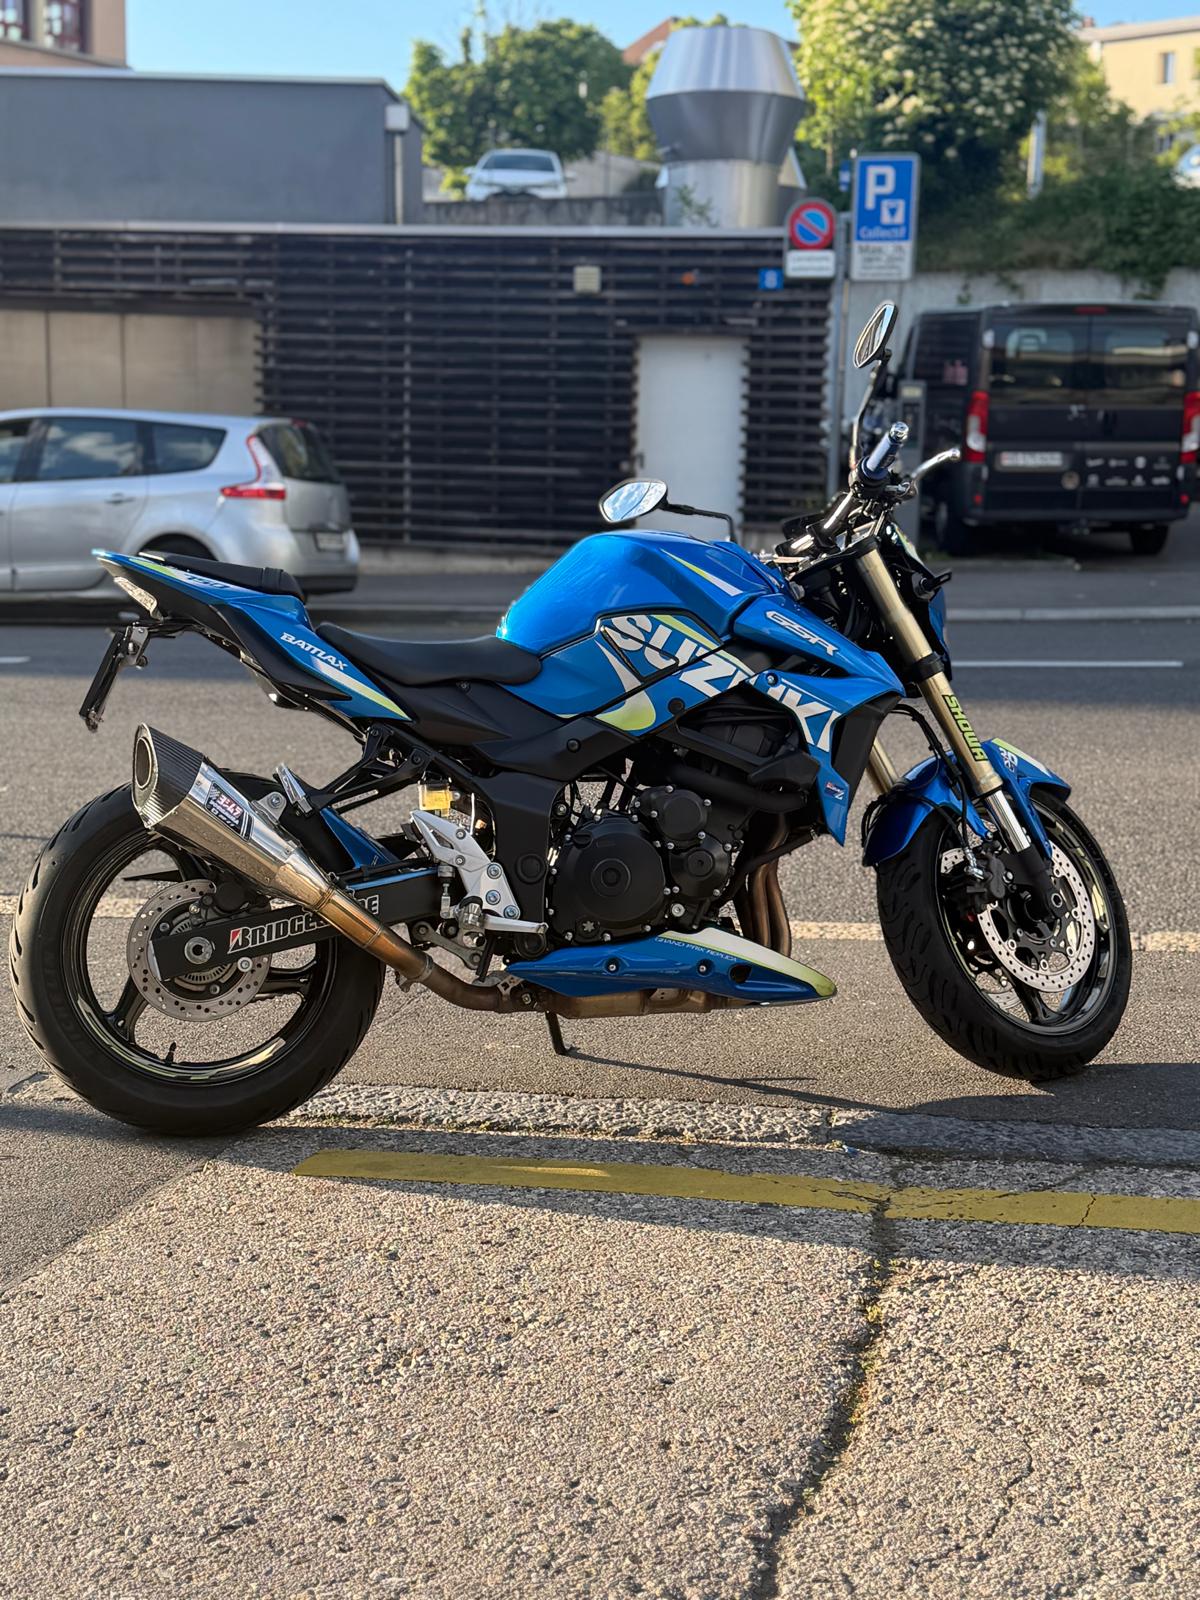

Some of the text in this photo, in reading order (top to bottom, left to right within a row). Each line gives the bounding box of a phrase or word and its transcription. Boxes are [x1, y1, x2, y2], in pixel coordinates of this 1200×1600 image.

[864, 165, 896, 210] P
[280, 631, 348, 671] BATTLAX
[765, 610, 839, 656] GSR
[941, 694, 988, 762] SHOWA
[227, 894, 379, 954] BRIDGEE
[654, 936, 738, 963] GRAND PRIX REPLICA
